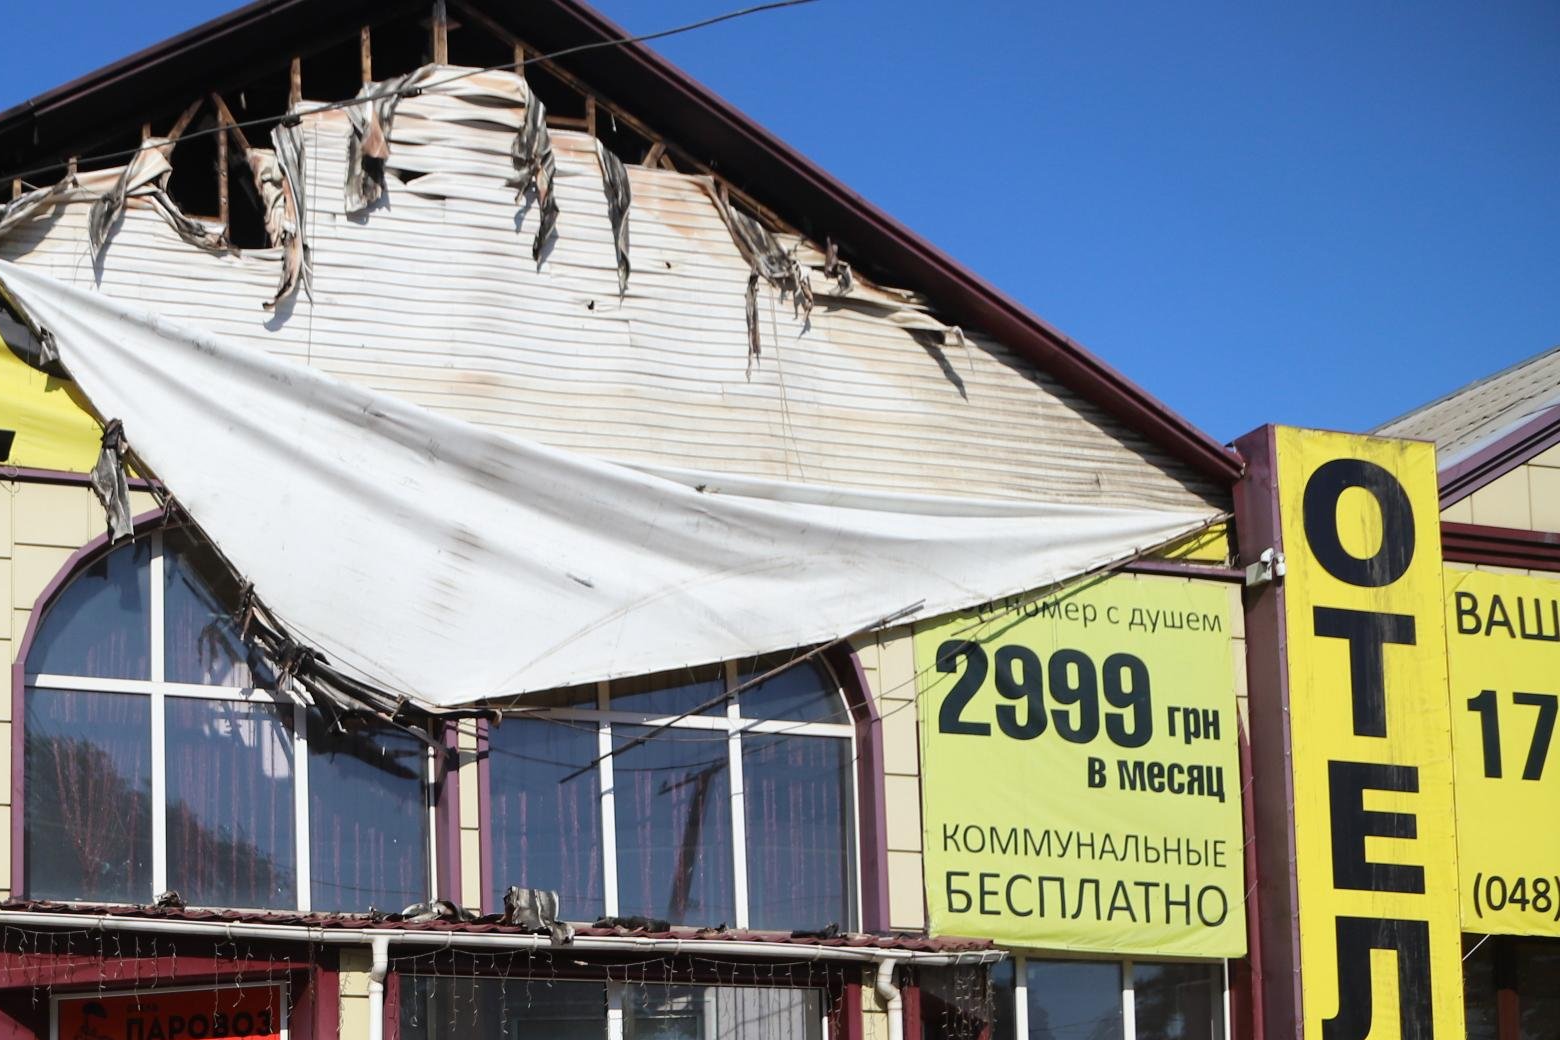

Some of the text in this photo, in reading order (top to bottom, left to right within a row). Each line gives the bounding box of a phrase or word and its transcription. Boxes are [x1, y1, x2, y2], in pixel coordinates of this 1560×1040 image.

[1106, 606, 1120, 624] с
[1128, 608, 1222, 633] душем
[936, 639, 1221, 749] 2999 грн
[1467, 689, 1559, 781] 17
[1117, 760, 1226, 803] месяц
[942, 823, 1227, 868] КОММУНАЛЬНЫЕ
[945, 870, 1229, 928] БЕСПЛАТНО
